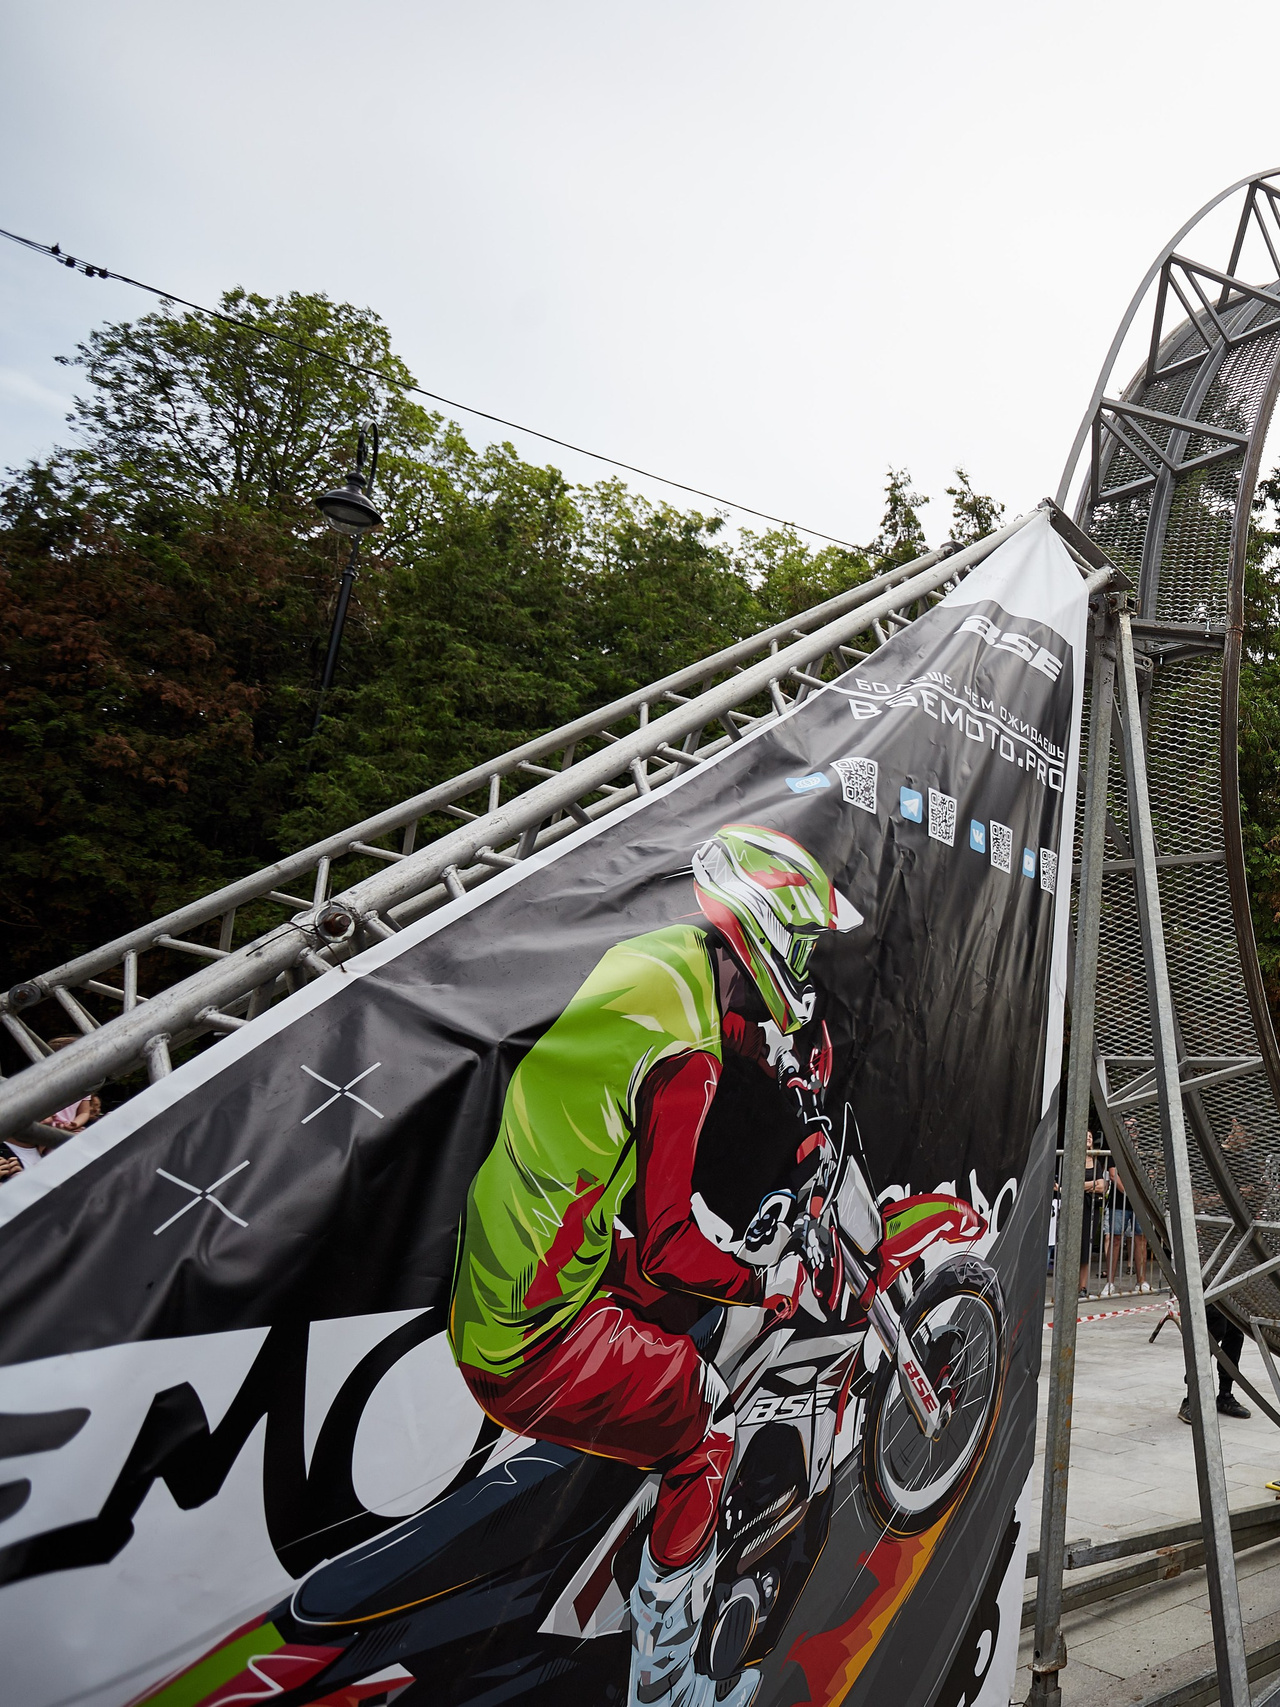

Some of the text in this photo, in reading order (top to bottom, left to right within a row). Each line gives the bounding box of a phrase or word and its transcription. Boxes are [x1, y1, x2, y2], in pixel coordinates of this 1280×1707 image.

[953, 614, 1064, 683] BSE
[963, 684, 995, 713] ЧЕМ
[999, 705, 1066, 760] ОЖИДАЕШЬ
[741, 1389, 837, 1426] BSE
[903, 1359, 938, 1415] BSE
